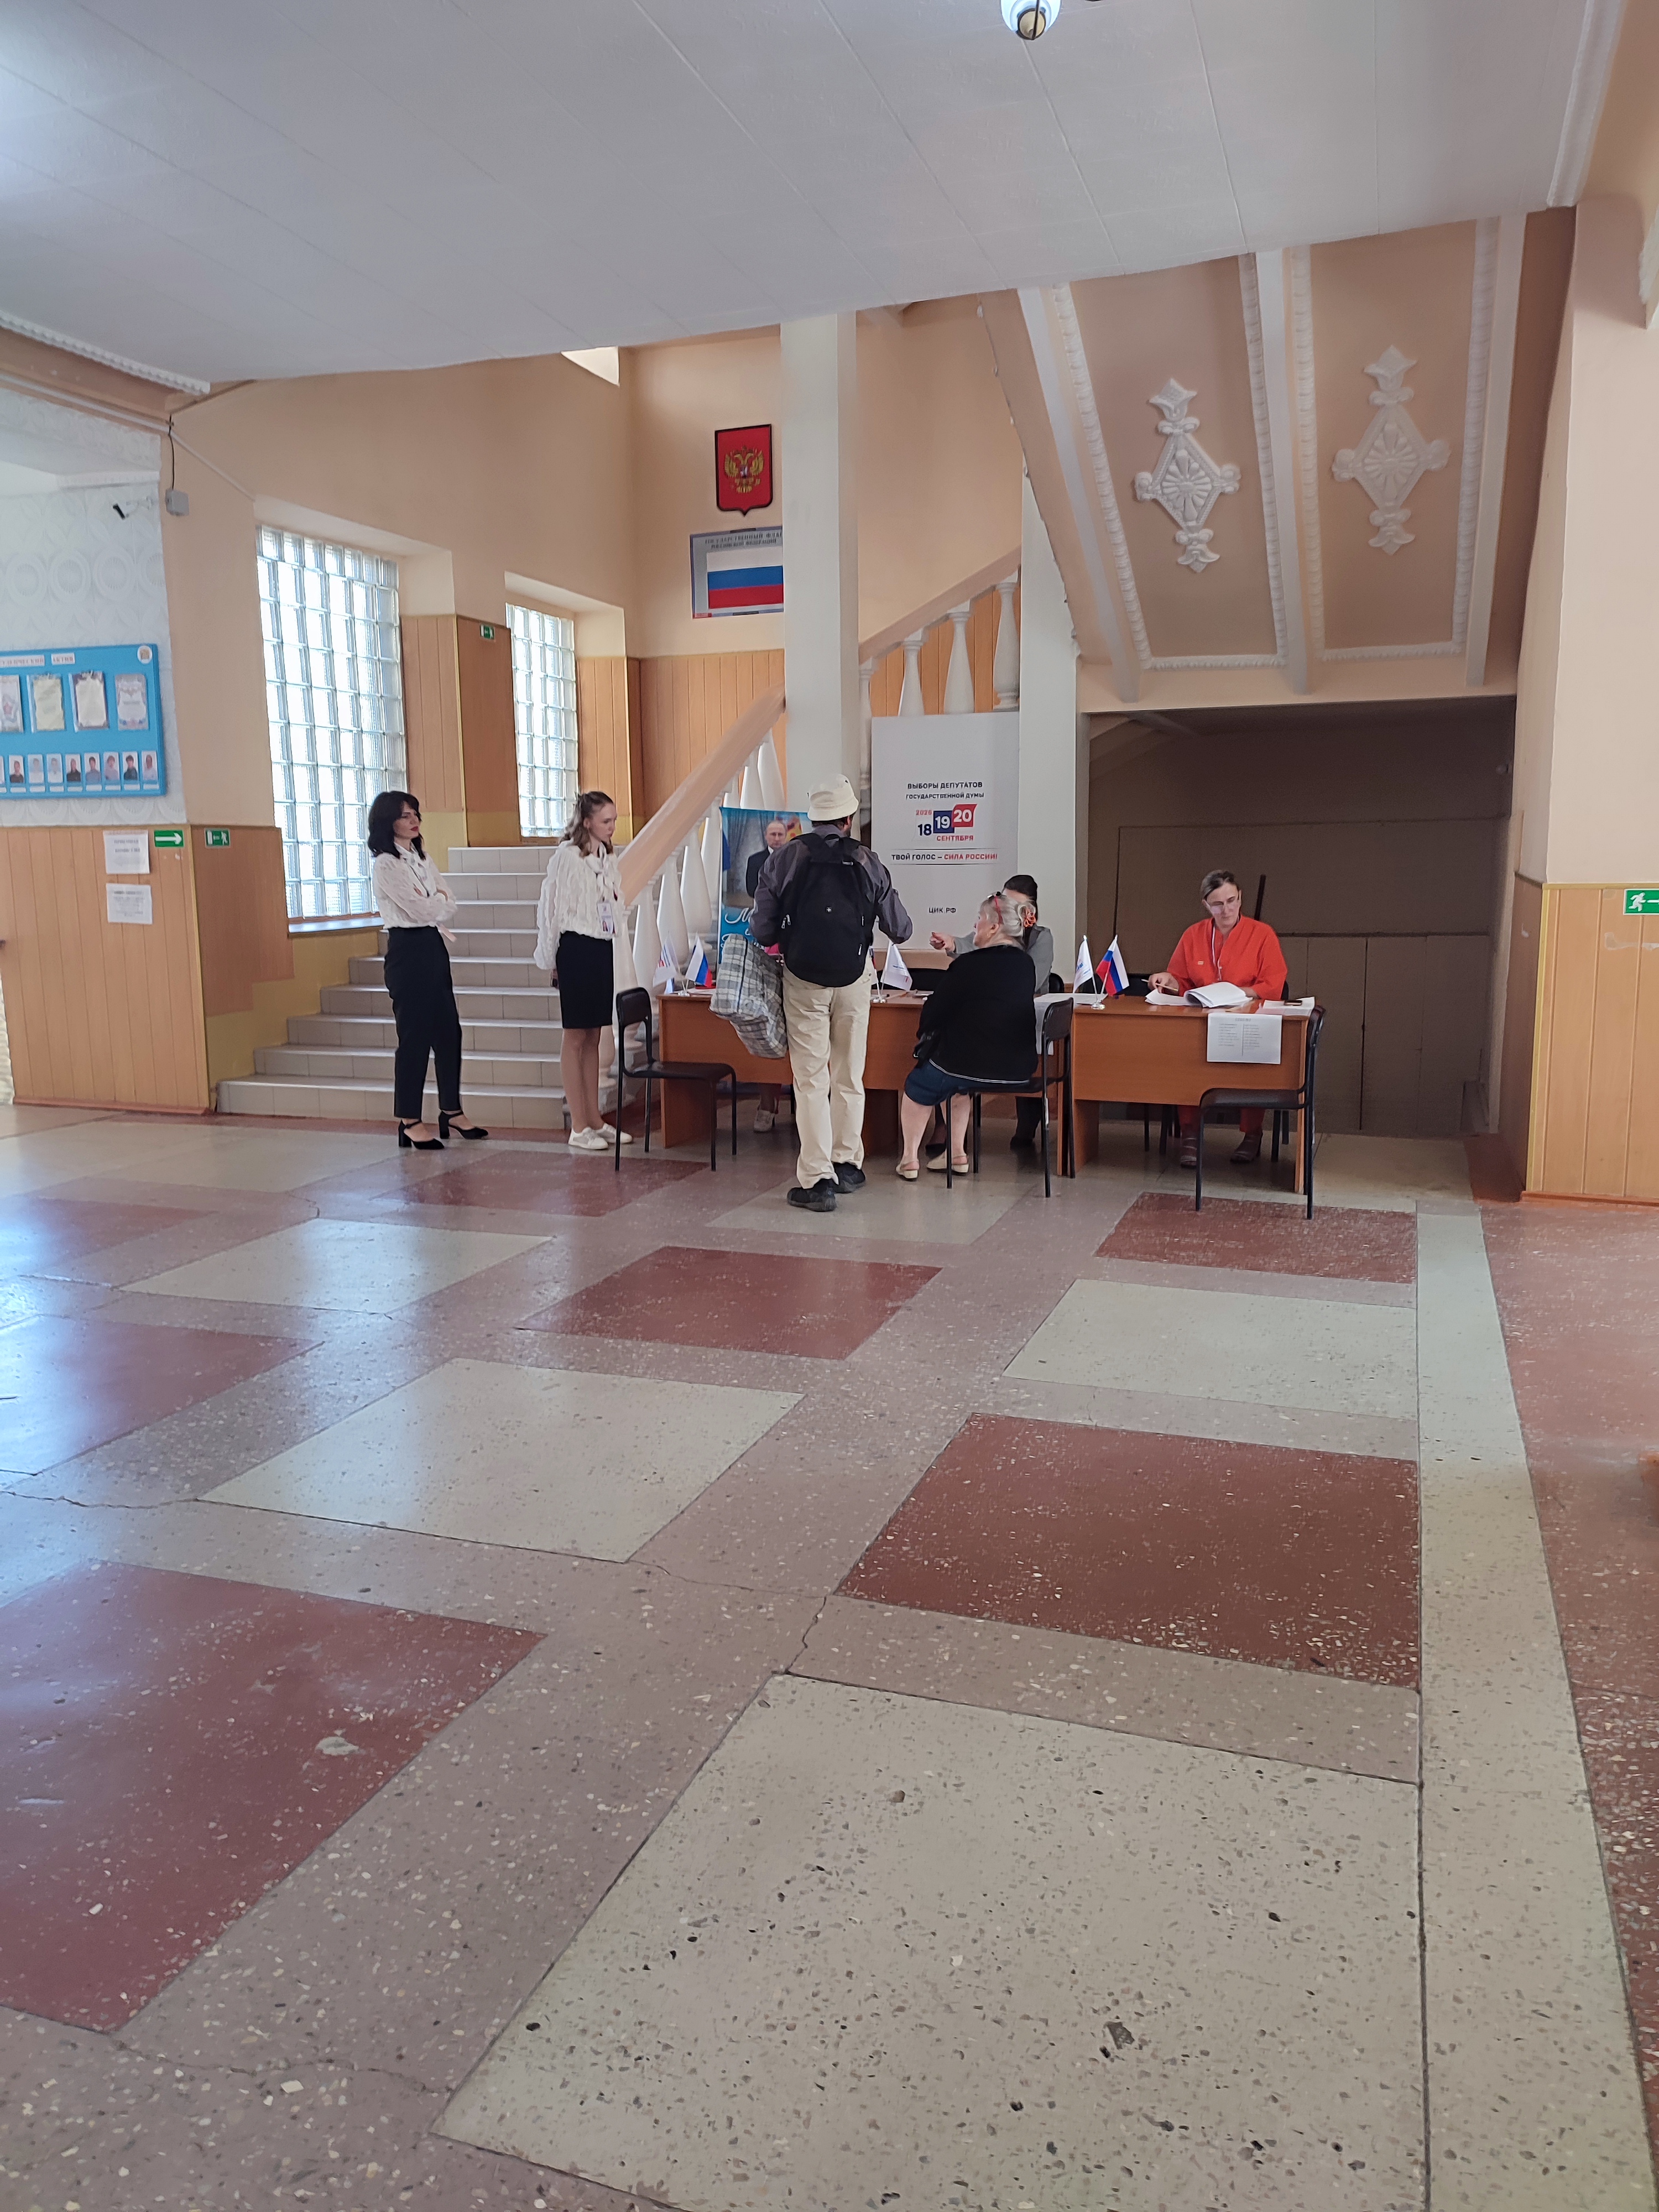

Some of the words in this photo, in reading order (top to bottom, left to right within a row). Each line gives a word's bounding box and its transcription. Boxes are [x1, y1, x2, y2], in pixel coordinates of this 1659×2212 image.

[940, 781, 983, 790] ДЕПУТАТОВ
[917, 823, 932, 836] 18
[935, 816, 951, 829] 19
[953, 809, 972, 823] 20
